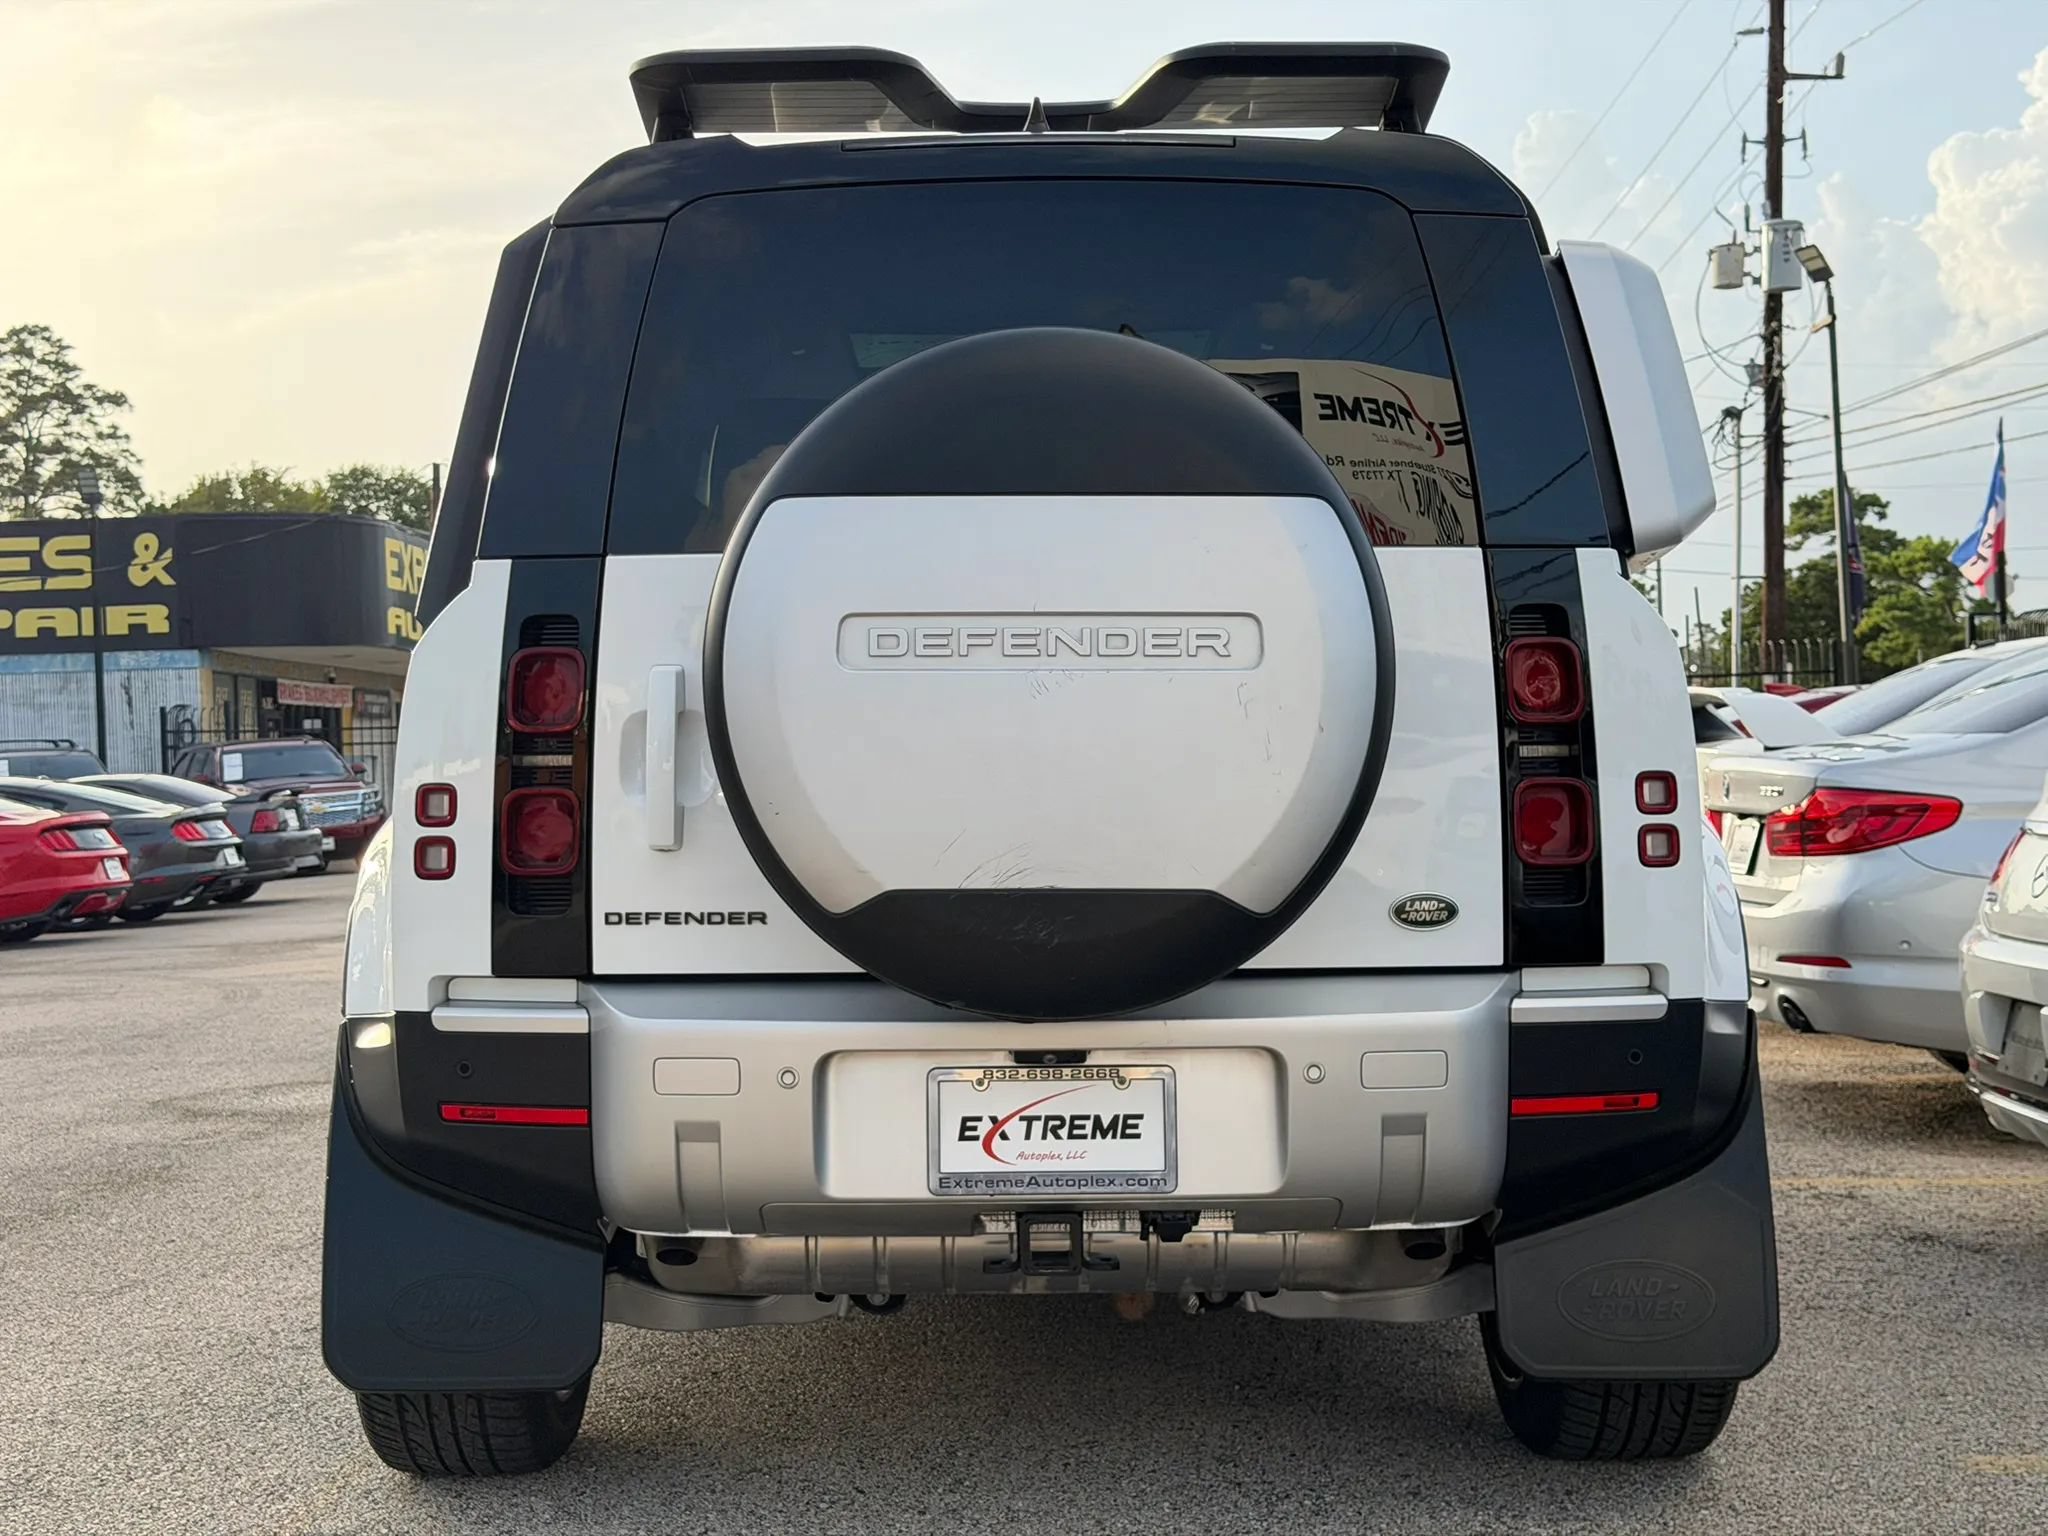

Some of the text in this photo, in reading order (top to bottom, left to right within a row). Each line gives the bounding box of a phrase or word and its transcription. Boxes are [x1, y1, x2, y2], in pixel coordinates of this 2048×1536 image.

[128, 532, 176, 587] &
[867, 626, 1231, 657] DEFENDER
[1405, 901, 1438, 911] LAND
[604, 911, 768, 925] DEFENDER
[1408, 911, 1448, 921] ROVER
[983, 1069, 1120, 1080] 832-698-2668
[957, 1113, 1144, 1141] EXTREME
[1015, 1150, 1088, 1162] Autoplex, LLC
[938, 1175, 1168, 1190] ExtremeAutoplex.com
[1591, 1277, 1663, 1298] LAND
[1598, 1300, 1687, 1321] ROVER
